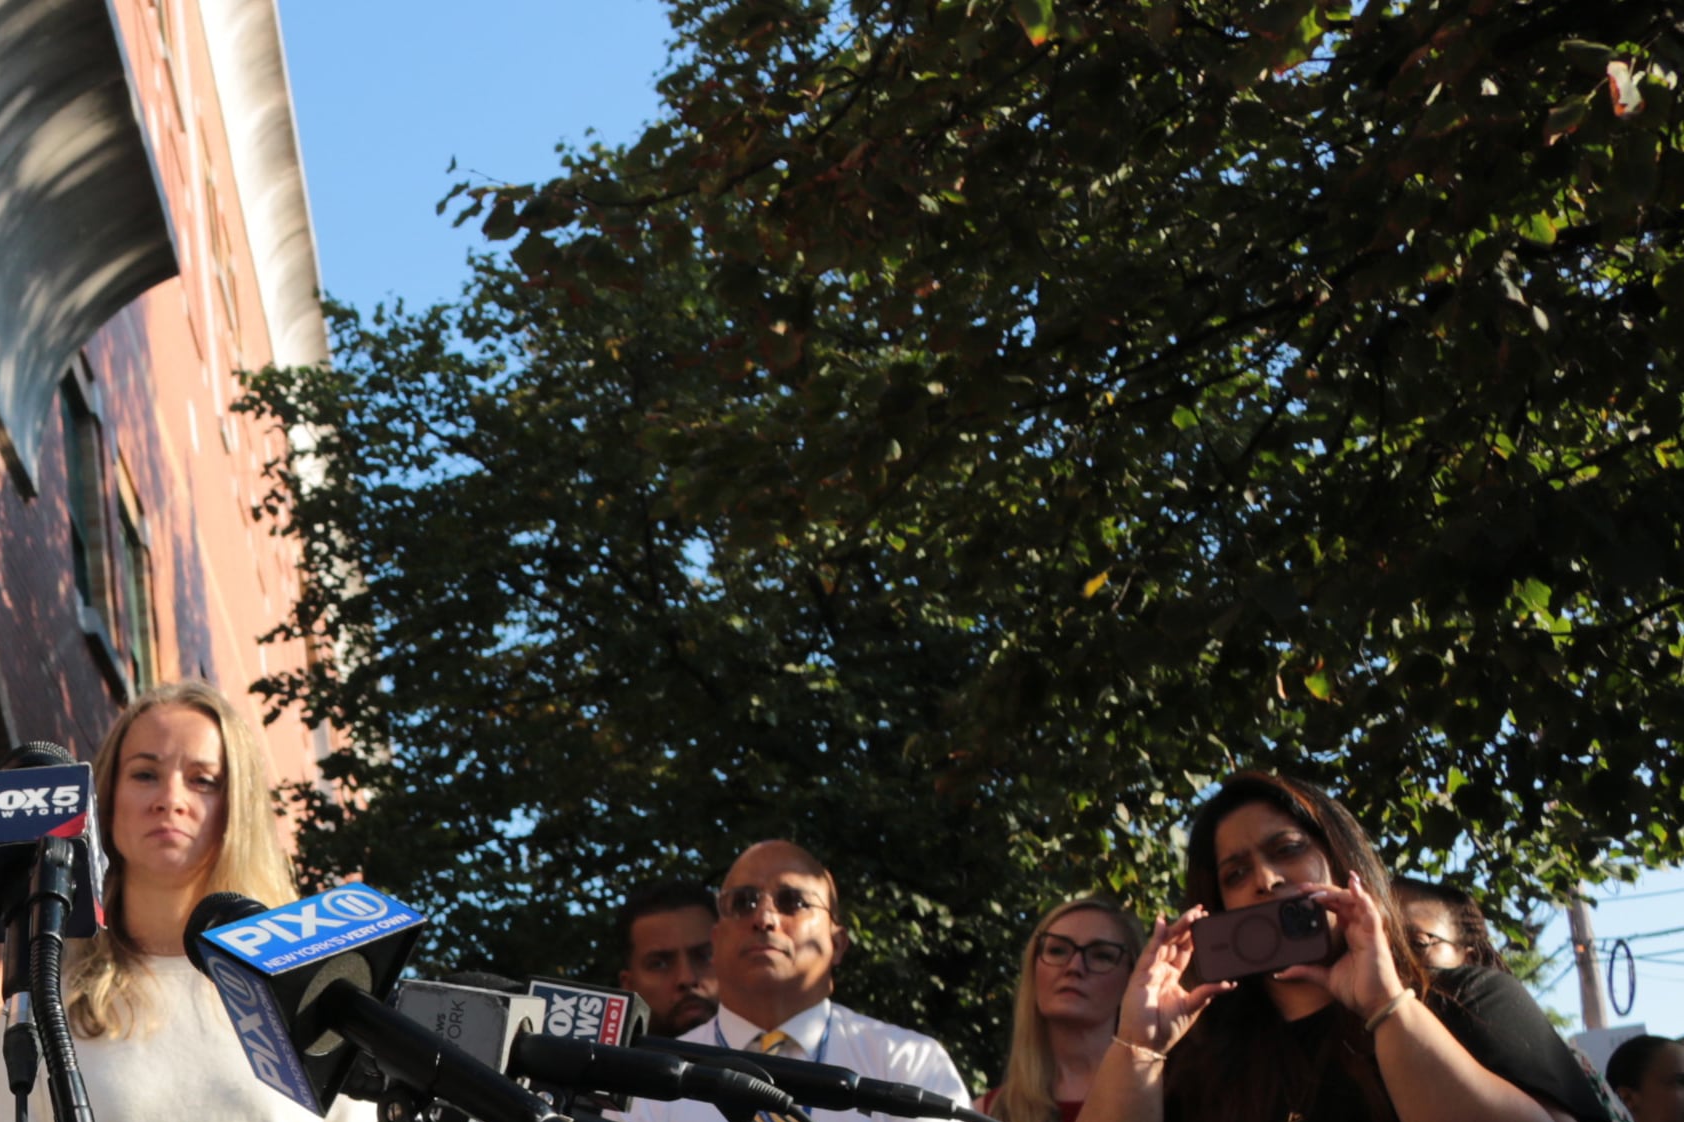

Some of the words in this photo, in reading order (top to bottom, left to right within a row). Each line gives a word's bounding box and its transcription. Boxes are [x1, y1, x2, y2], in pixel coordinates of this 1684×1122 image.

[24, 806, 78, 817] YORK
[51, 785, 81, 808] 5
[217, 903, 350, 957] PIX
[262, 954, 298, 970] NEW
[294, 935, 346, 957] YORK'S
[340, 924, 379, 942] VERY
[377, 912, 413, 930] OWN
[447, 1000, 465, 1042] ORK
[548, 992, 579, 1037] OX
[573, 992, 605, 1044] WS
[604, 1001, 620, 1045] nnel
[225, 994, 295, 1098] PIX
